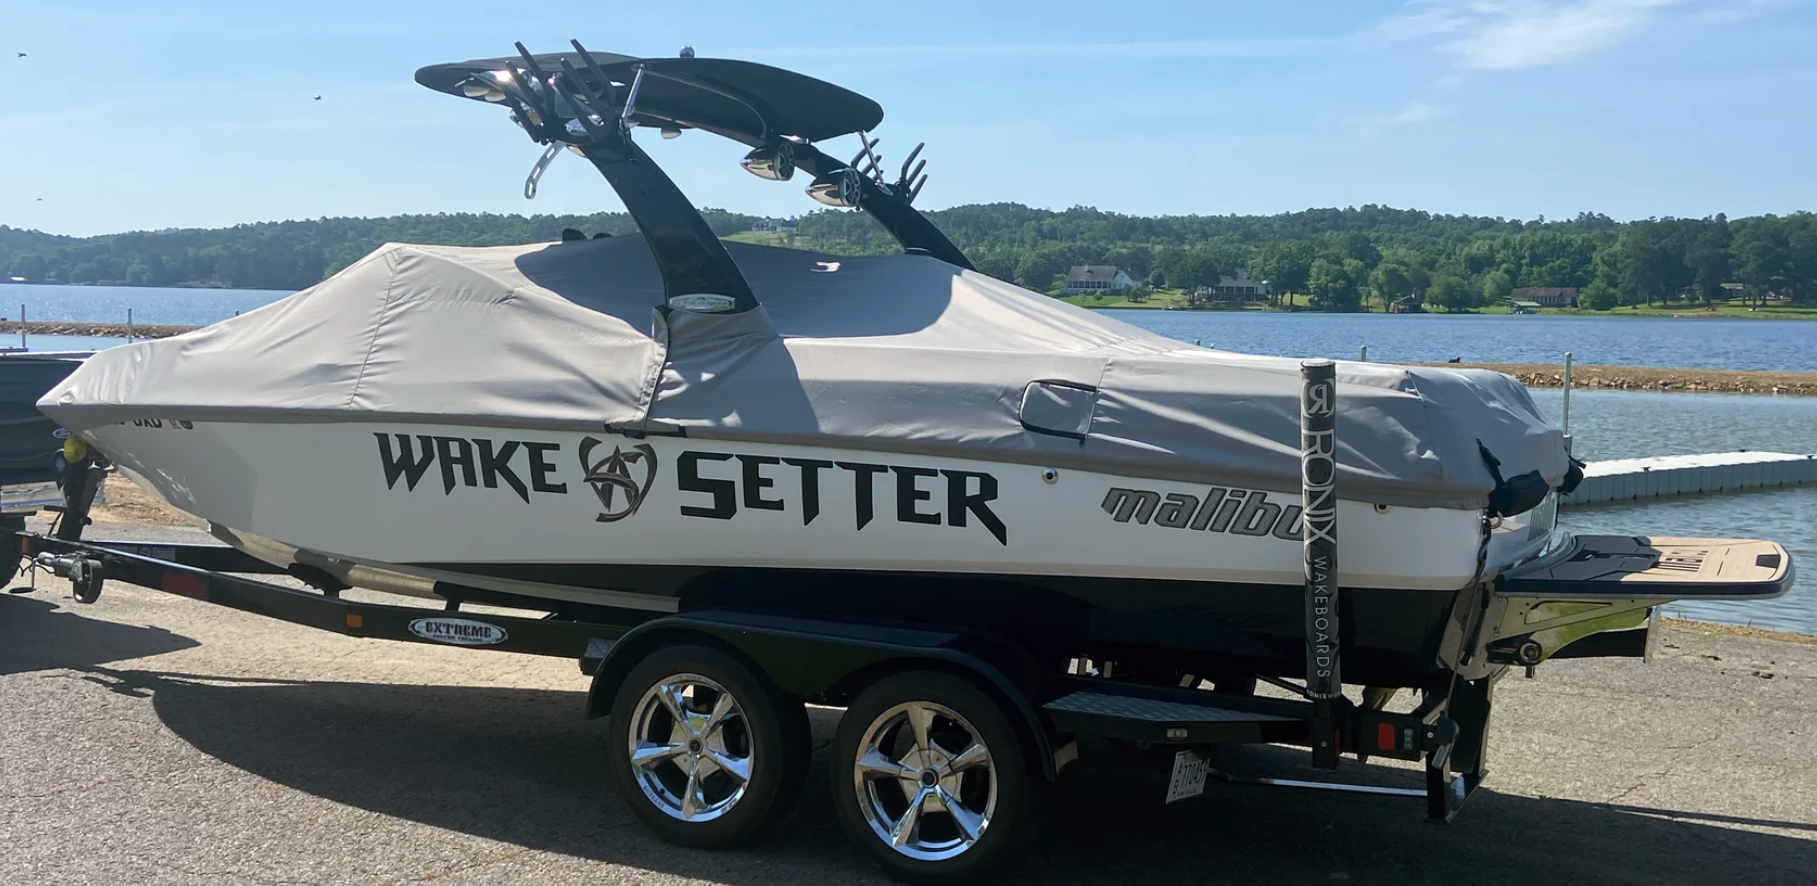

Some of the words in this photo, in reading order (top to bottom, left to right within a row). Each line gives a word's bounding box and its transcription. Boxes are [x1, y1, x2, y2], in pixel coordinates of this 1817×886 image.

[373, 432, 567, 504] WAKE
[677, 450, 1007, 546] SETTER
[1301, 429, 1337, 546] RONIX
[1314, 555, 1331, 677] WAKEBOARDS
